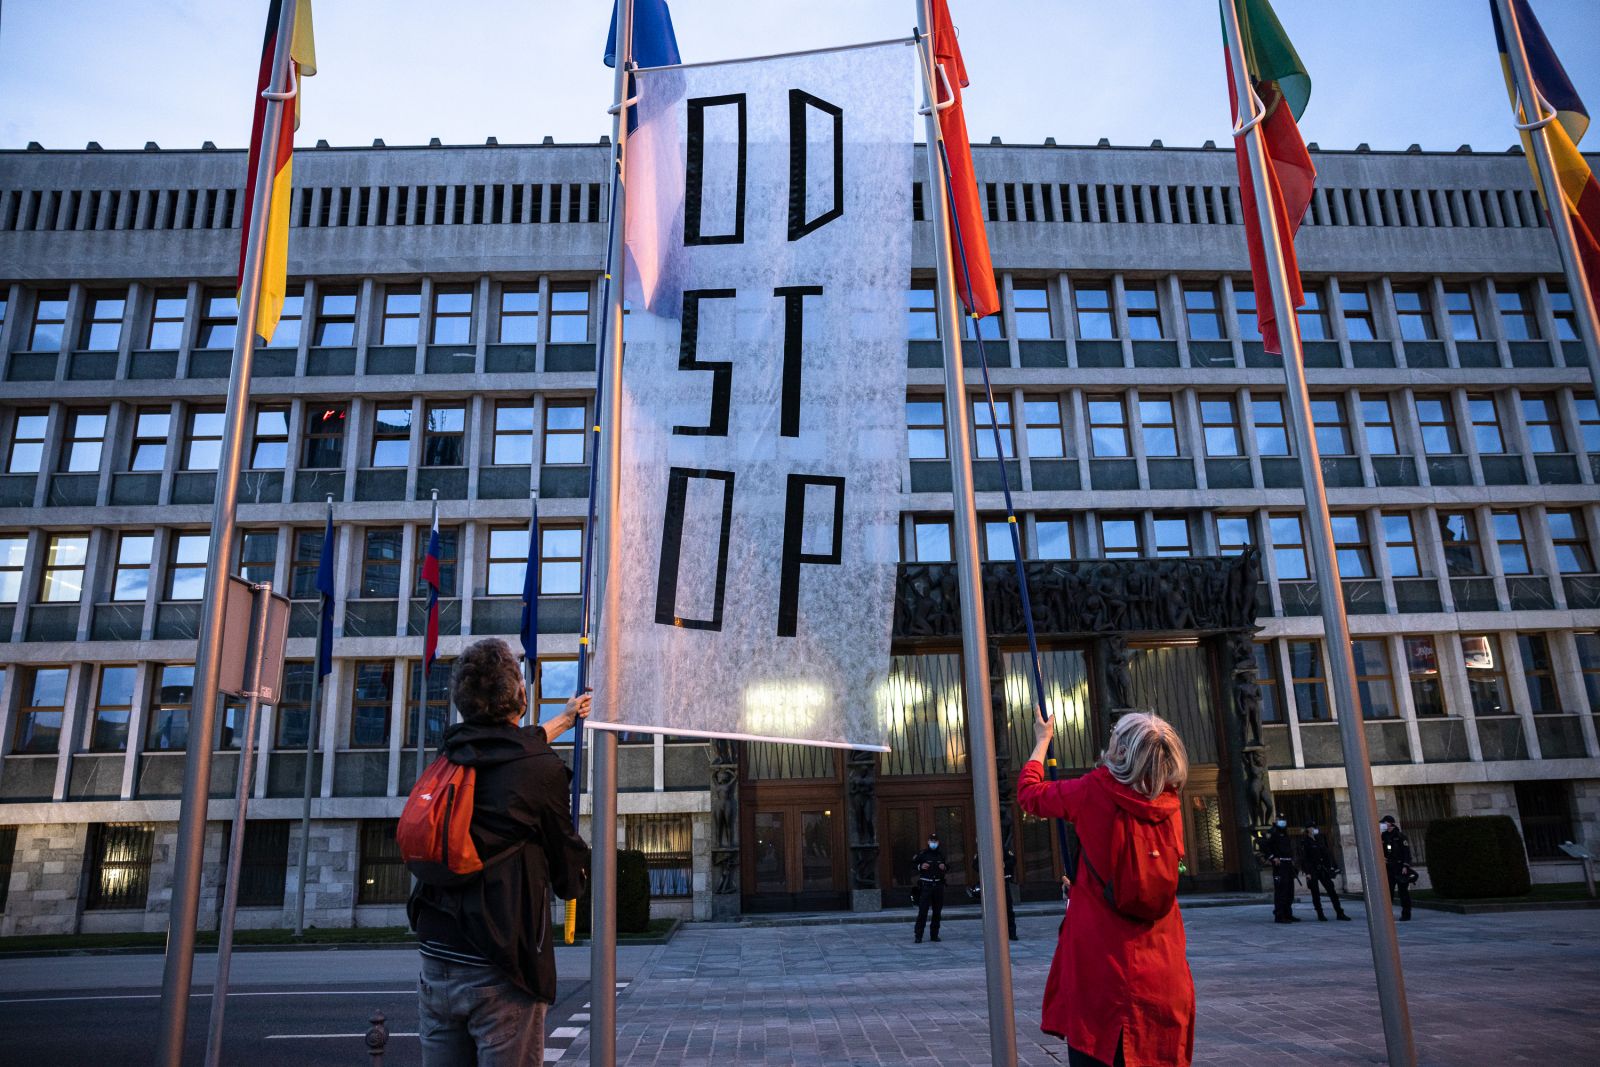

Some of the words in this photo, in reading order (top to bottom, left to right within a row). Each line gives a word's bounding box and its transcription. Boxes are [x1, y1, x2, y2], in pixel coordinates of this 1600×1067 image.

[683, 88, 843, 246] OD
[673, 286, 823, 437] ST
[655, 467, 846, 637] OP
